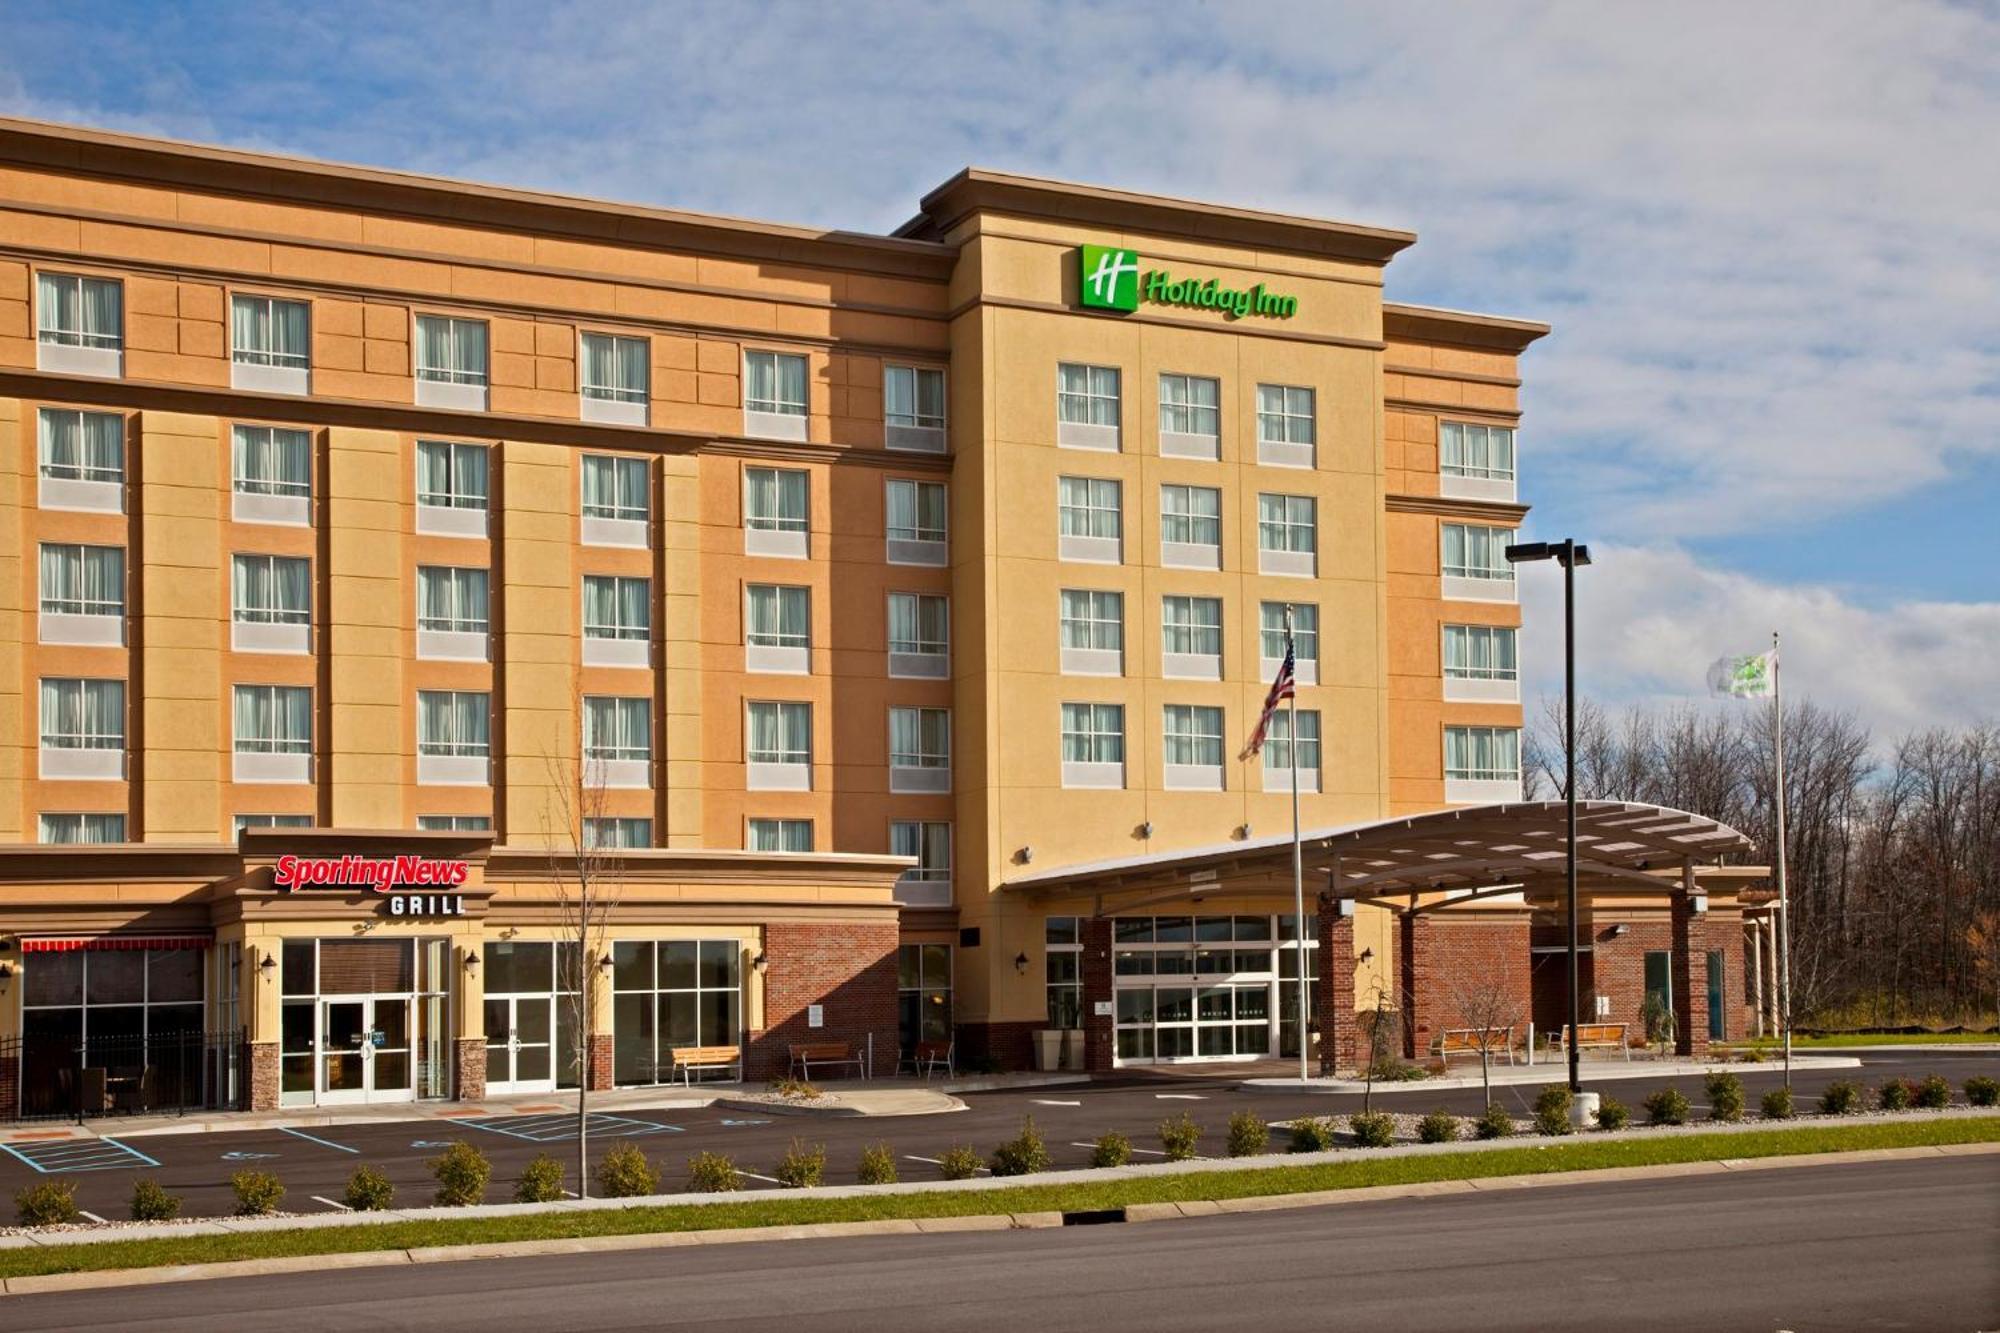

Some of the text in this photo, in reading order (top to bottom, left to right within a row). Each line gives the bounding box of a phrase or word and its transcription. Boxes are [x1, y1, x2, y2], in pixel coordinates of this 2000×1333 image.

[1146, 270, 1298, 318] Holiday Inn
[391, 895, 466, 915] GRILL
